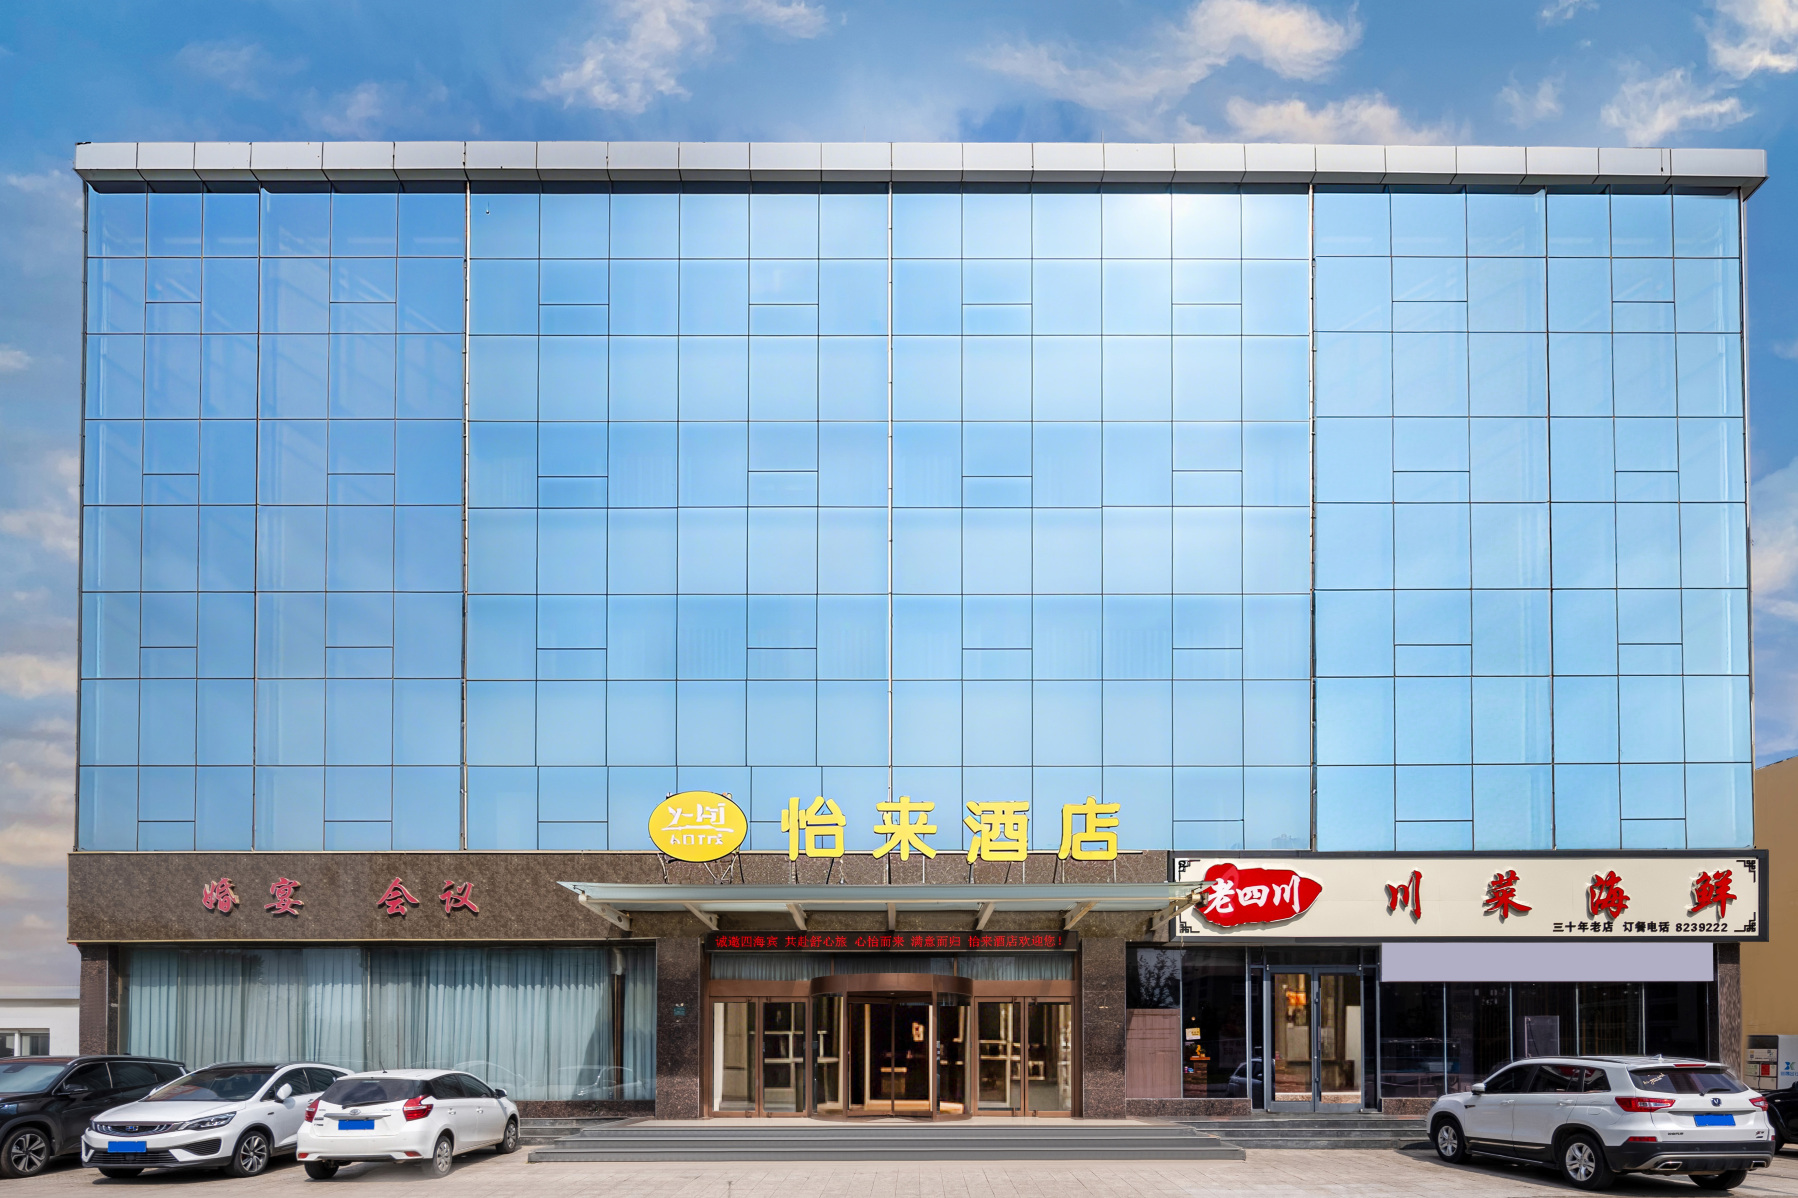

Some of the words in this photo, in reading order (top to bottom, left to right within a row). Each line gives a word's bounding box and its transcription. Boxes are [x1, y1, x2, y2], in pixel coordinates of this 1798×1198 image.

[781, 796, 1121, 863] 怡来酒店
[202, 877, 304, 915] 婚宴
[376, 877, 479, 914] 会议
[1203, 874, 1301, 914] 老四川
[910, 935, 961, 948] 满意而归
[1552, 922, 1614, 932] 三十年老店
[1622, 921, 1670, 932] 订餐电话
[1675, 923, 1728, 932] 8239222
